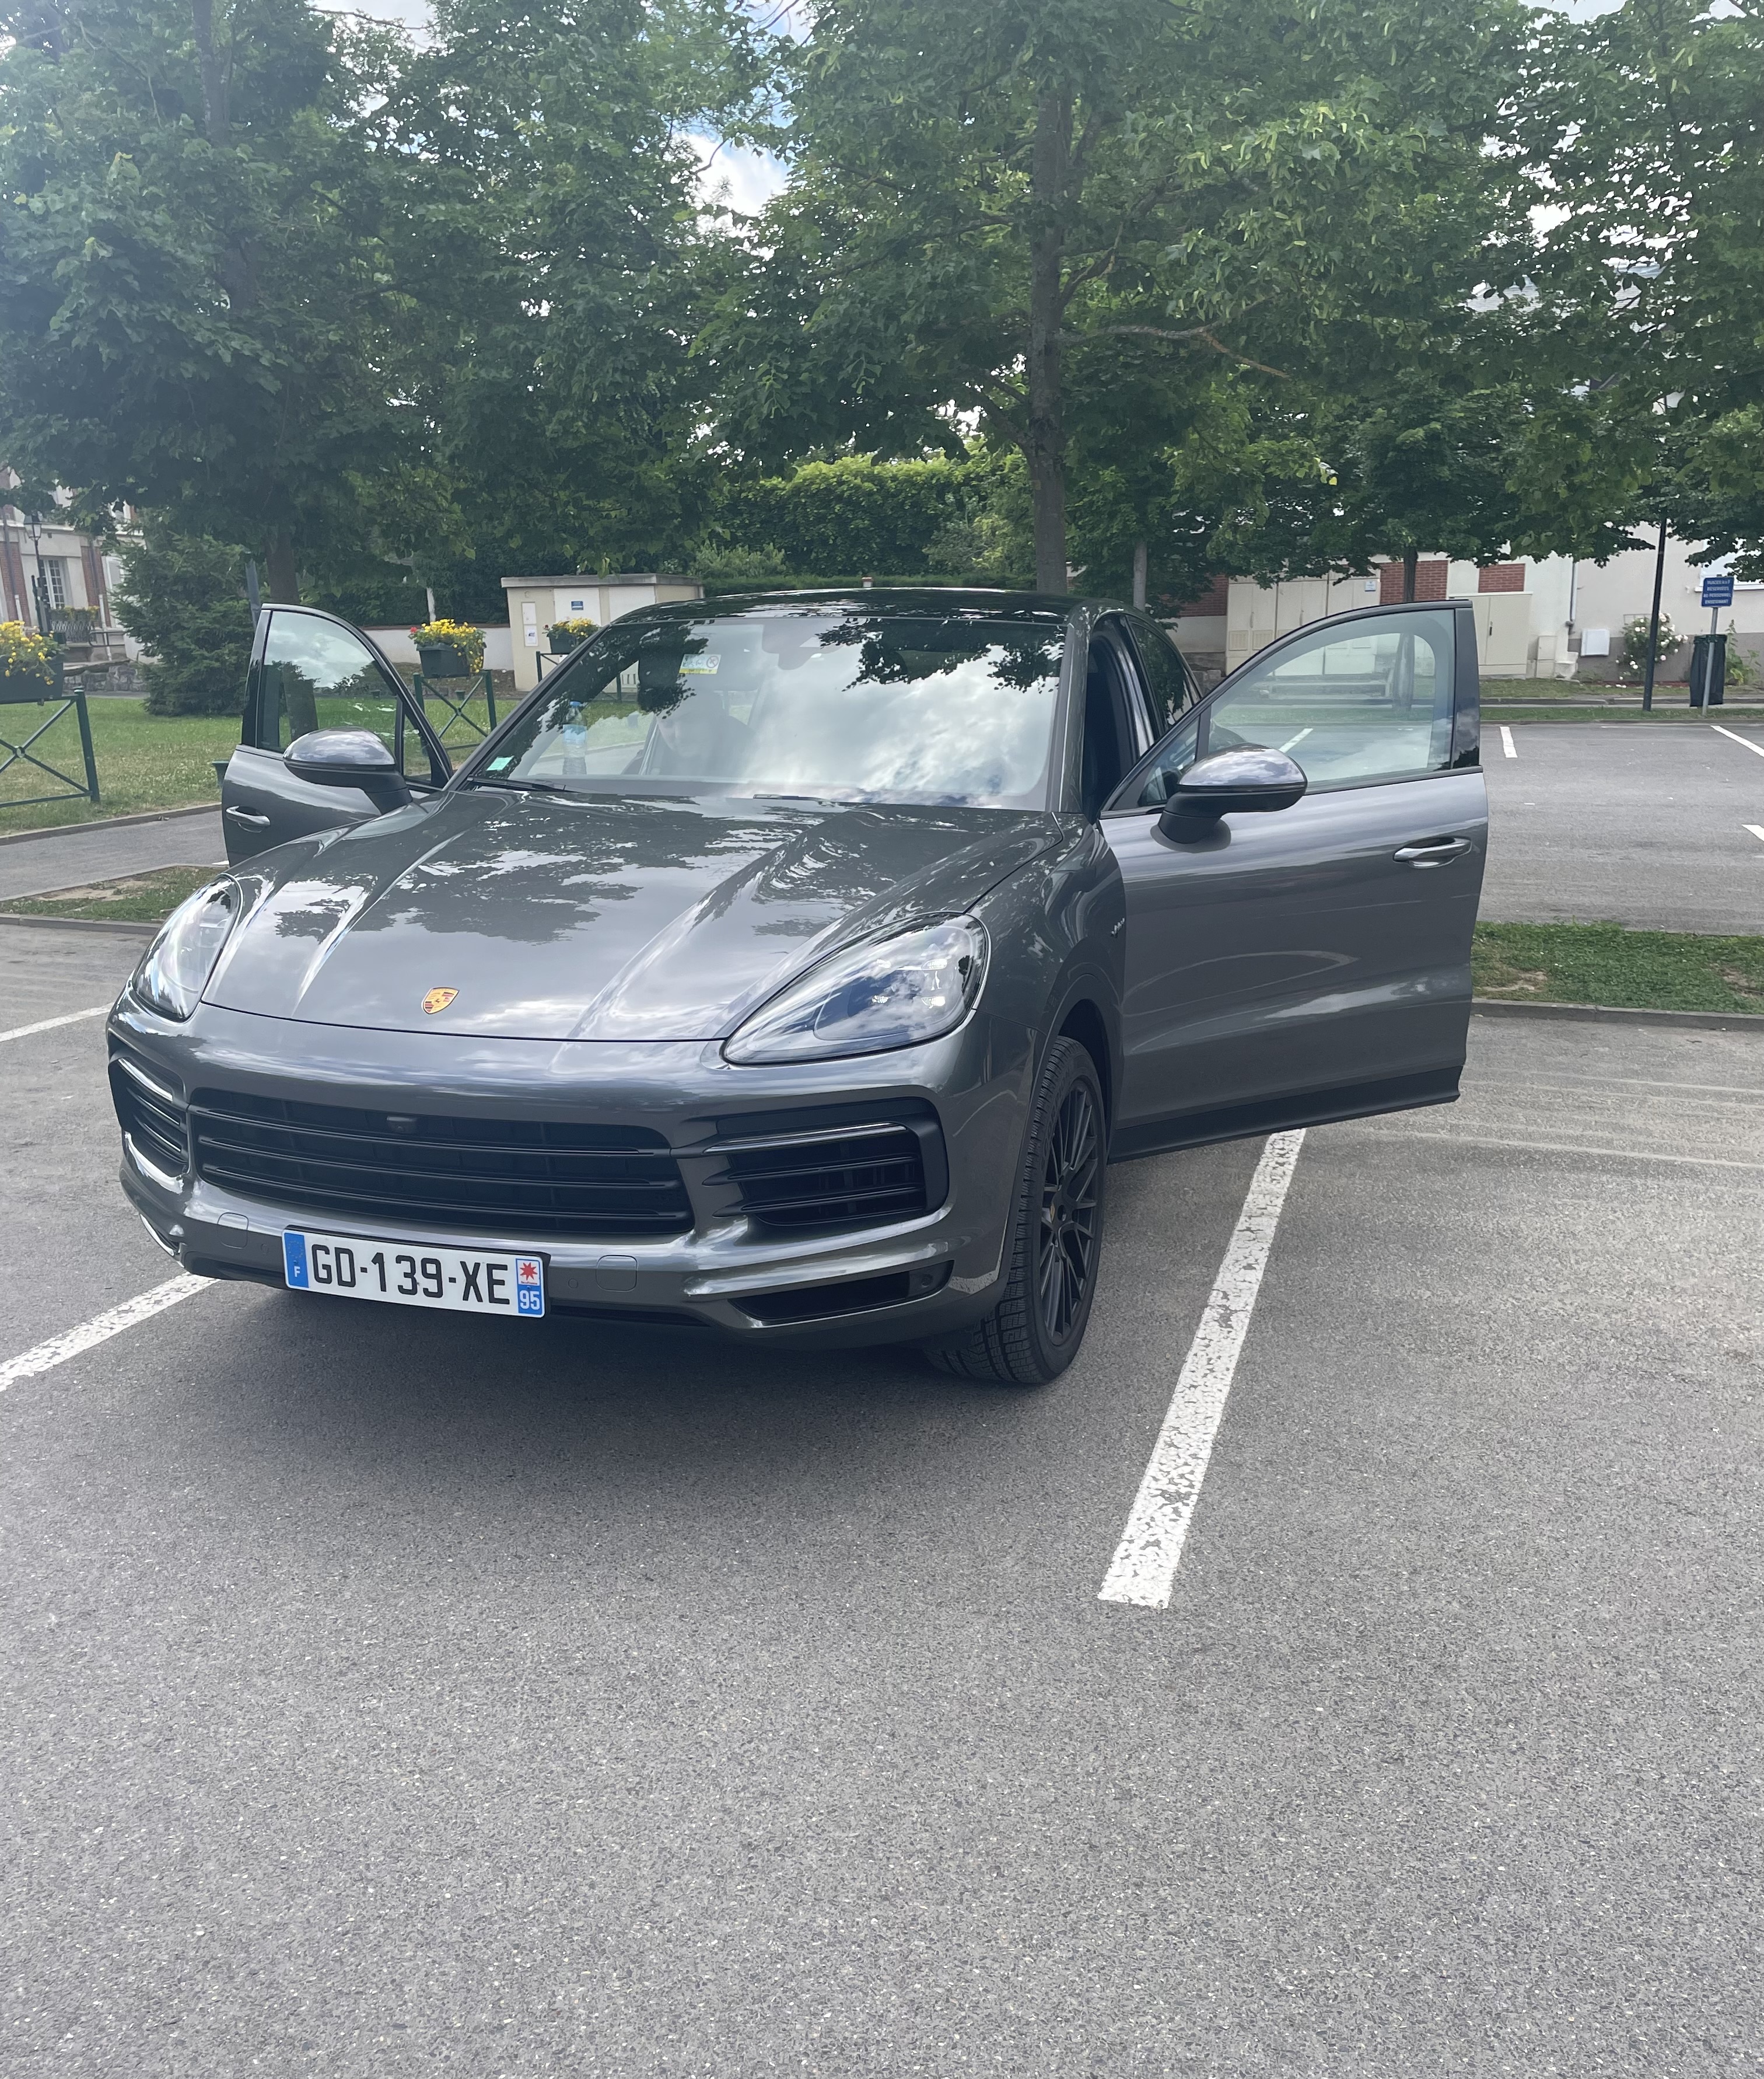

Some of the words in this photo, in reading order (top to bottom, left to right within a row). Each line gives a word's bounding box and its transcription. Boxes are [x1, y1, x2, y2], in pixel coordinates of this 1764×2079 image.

[293, 1265, 301, 1278] F
[311, 1243, 510, 1305] GD-139-XE
[519, 1290, 540, 1311] 95
